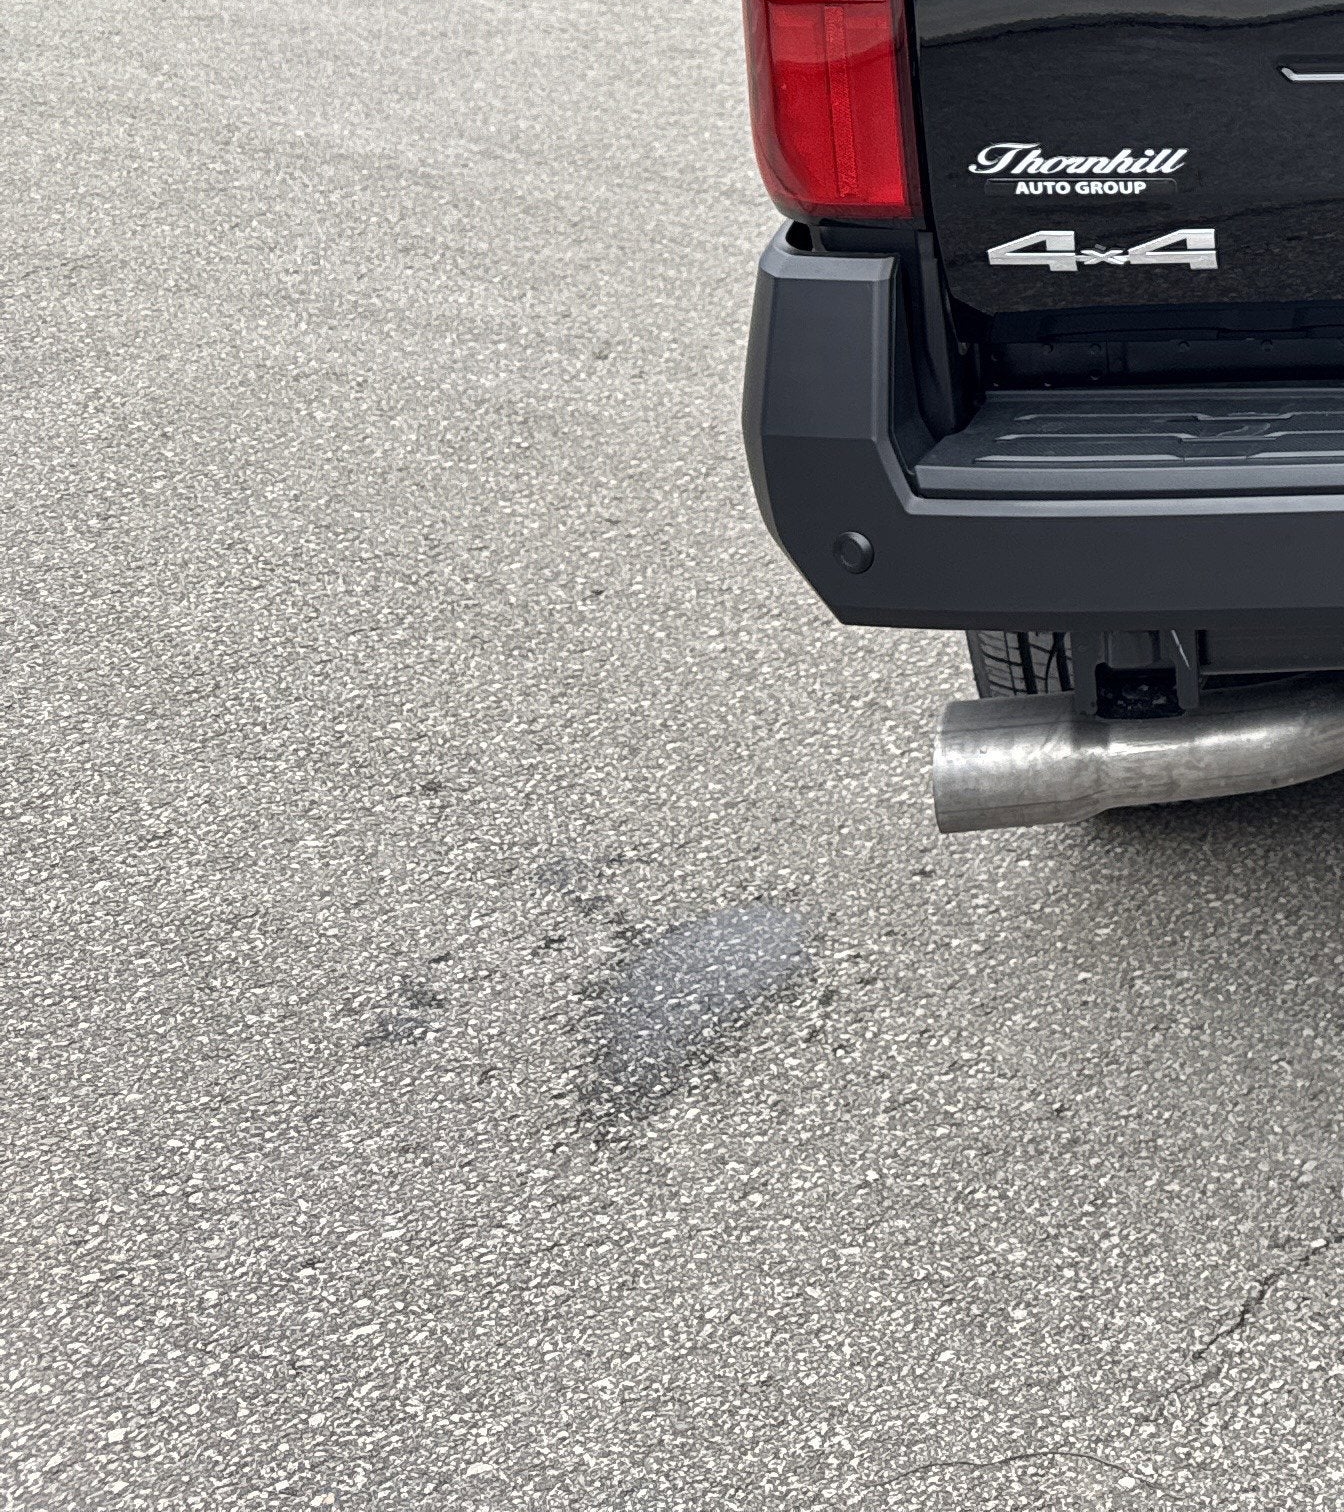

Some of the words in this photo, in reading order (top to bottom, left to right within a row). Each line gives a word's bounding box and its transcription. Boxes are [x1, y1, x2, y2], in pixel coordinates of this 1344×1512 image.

[968, 142, 1189, 175] Thornhill
[1015, 180, 1072, 195] AUTO
[1075, 180, 1147, 195] GROUP
[987, 228, 1219, 272] 4x4
